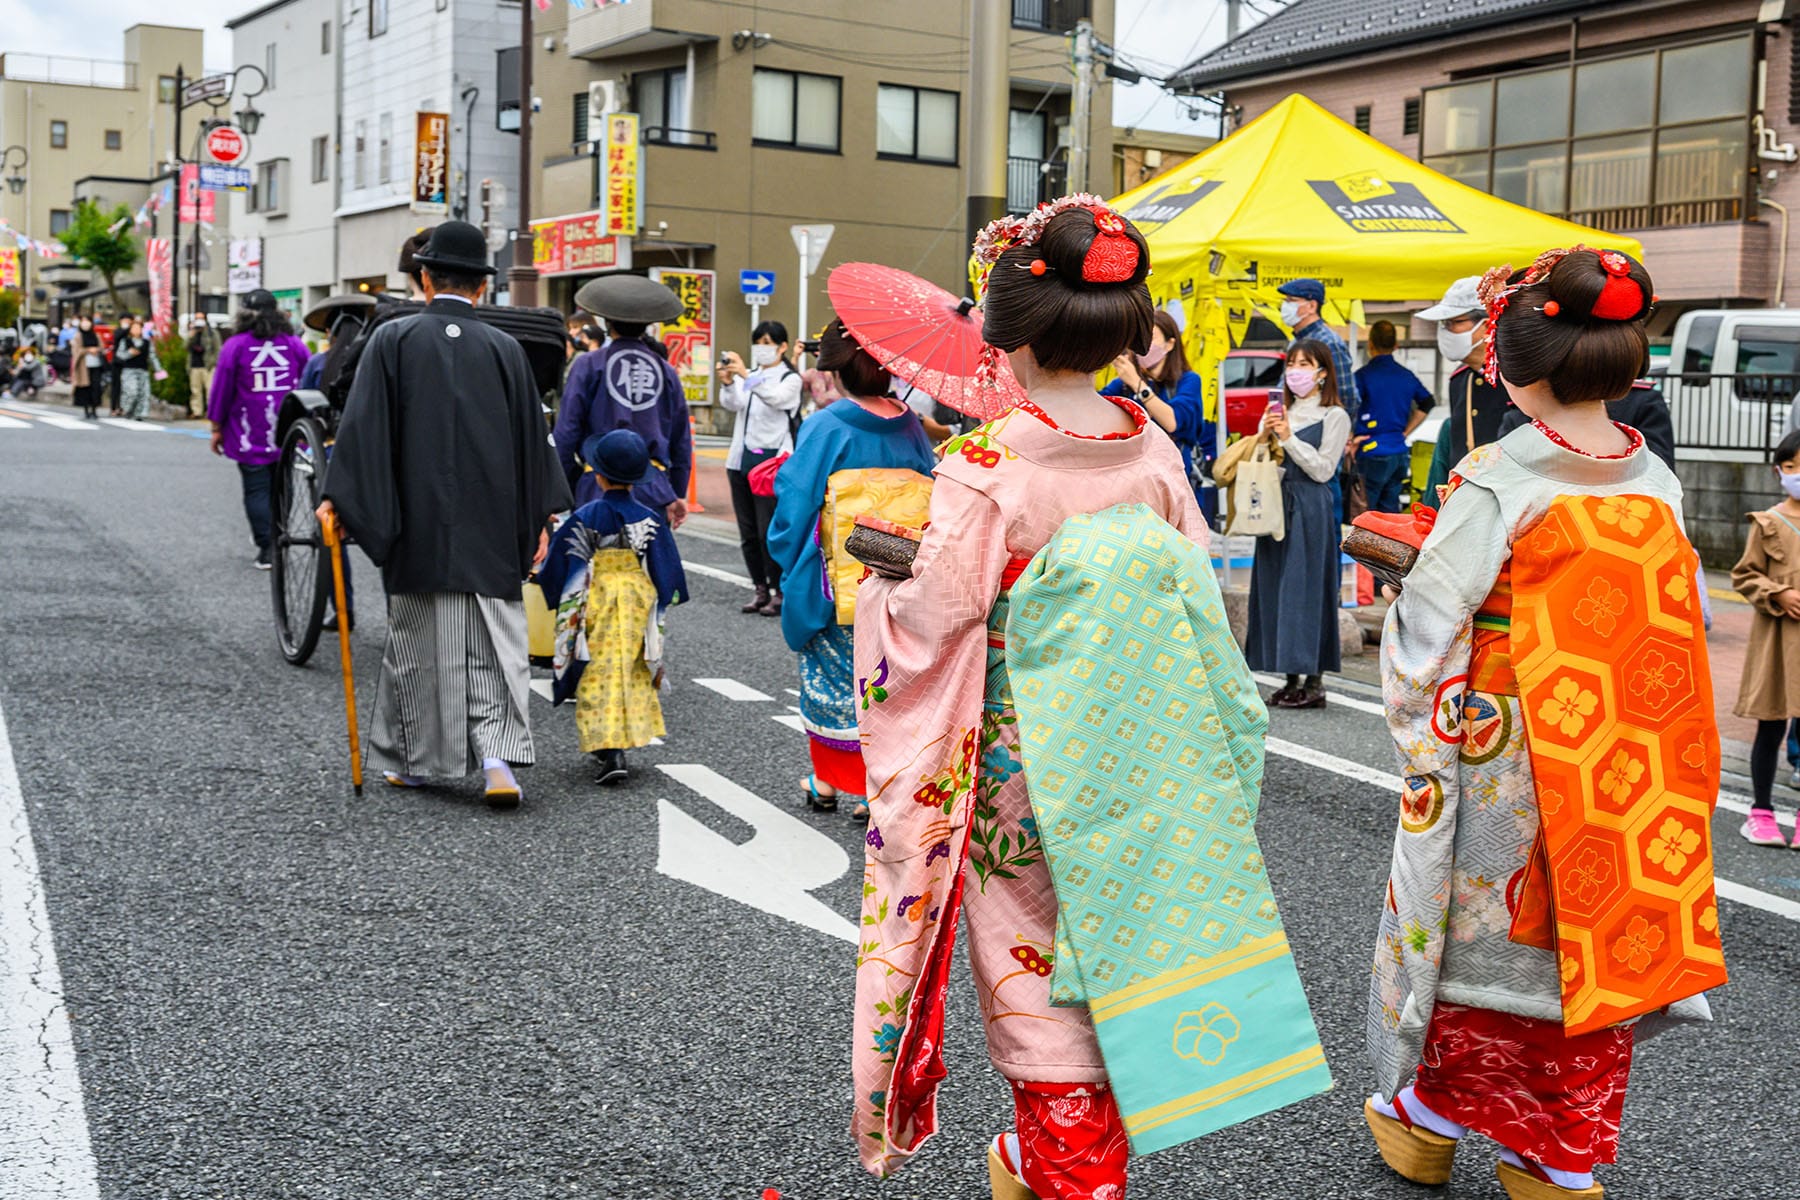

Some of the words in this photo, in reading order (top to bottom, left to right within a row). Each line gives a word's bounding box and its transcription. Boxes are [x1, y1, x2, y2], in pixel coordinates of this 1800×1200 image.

[1336, 205, 1443, 219] SAITAMA
[1352, 219, 1459, 231] CRITERIUM
[249, 341, 291, 392] 大正
